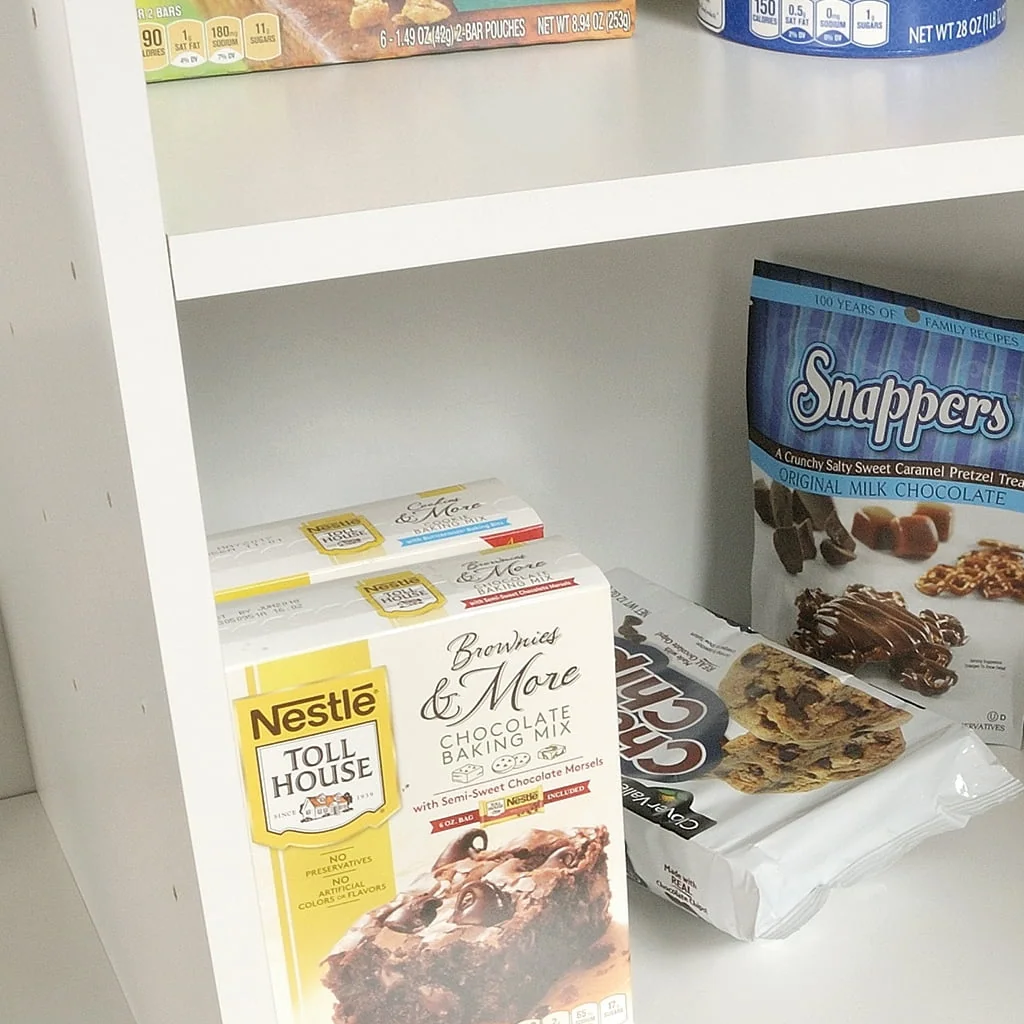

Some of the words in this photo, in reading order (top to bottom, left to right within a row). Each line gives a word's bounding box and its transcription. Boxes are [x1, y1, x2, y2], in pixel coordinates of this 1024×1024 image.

[156, 7, 181, 17] BARS
[395, 28, 415, 46] 1.49
[418, 29, 431, 45] OZ
[456, 22, 484, 41] 2-BAR
[485, 18, 526, 39] POUCHES
[537, 16, 556, 35] NET
[556, 14, 570, 34] WT
[572, 13, 590, 31] 8.94
[593, 13, 605, 30] OZ
[606, 10, 631, 33] (253g)
[856, 21, 882, 29] SUGARS
[909, 25, 933, 44] NET
[936, 22, 955, 41] WT
[956, 20, 967, 38] 28
[969, 15, 982, 35] OZ
[175, 43, 188, 51] SAT
[212, 39, 239, 47] SODIUM
[250, 35, 276, 44] SUGARS
[814, 293, 833, 308] 100
[836, 298, 876, 317] YEARS
[879, 307, 897, 320] OF
[924, 317, 967, 336] FAMILY
[970, 326, 1019, 346] RECIPES
[790, 346, 1009, 447] Snappers
[775, 448, 783, 460] A
[784, 450, 824, 471] Crunchy
[826, 459, 852, 475] Salty
[855, 461, 891, 475] Sweet
[895, 463, 945, 477] Caramel
[950, 468, 994, 483] Pretzel
[779, 467, 842, 495] ORIGINAL
[850, 480, 887, 497] MILK
[895, 481, 1007, 506] CHOCOLATE
[321, 531, 368, 544] HOUSE
[477, 581, 525, 596] BAKING
[532, 574, 553, 585] MIX
[380, 590, 428, 604] HOUSE
[447, 627, 562, 671] Brownies
[420, 677, 462, 720] &
[446, 652, 581, 727] More
[440, 705, 571, 749] CHOCOLATE
[442, 733, 524, 765] BAKING
[534, 721, 572, 742] MIX
[283, 739, 356, 771] TOLL
[271, 757, 374, 798] HOUSE
[413, 798, 439, 813] with
[442, 783, 505, 807] Semi-Sweet
[507, 769, 562, 789] Chocolate
[565, 757, 604, 774] Morsels
[546, 785, 585, 800] INCLUDED
[458, 814, 474, 823] BAG
[305, 856, 373, 877] PRESERVATIVES
[329, 853, 347, 864] NO
[319, 882, 365, 898] ARTIFICIAL
[332, 876, 350, 886] NO
[671, 875, 692, 894] REAL
[298, 896, 335, 911] COLORS
[348, 883, 387, 898] FLAVORS
